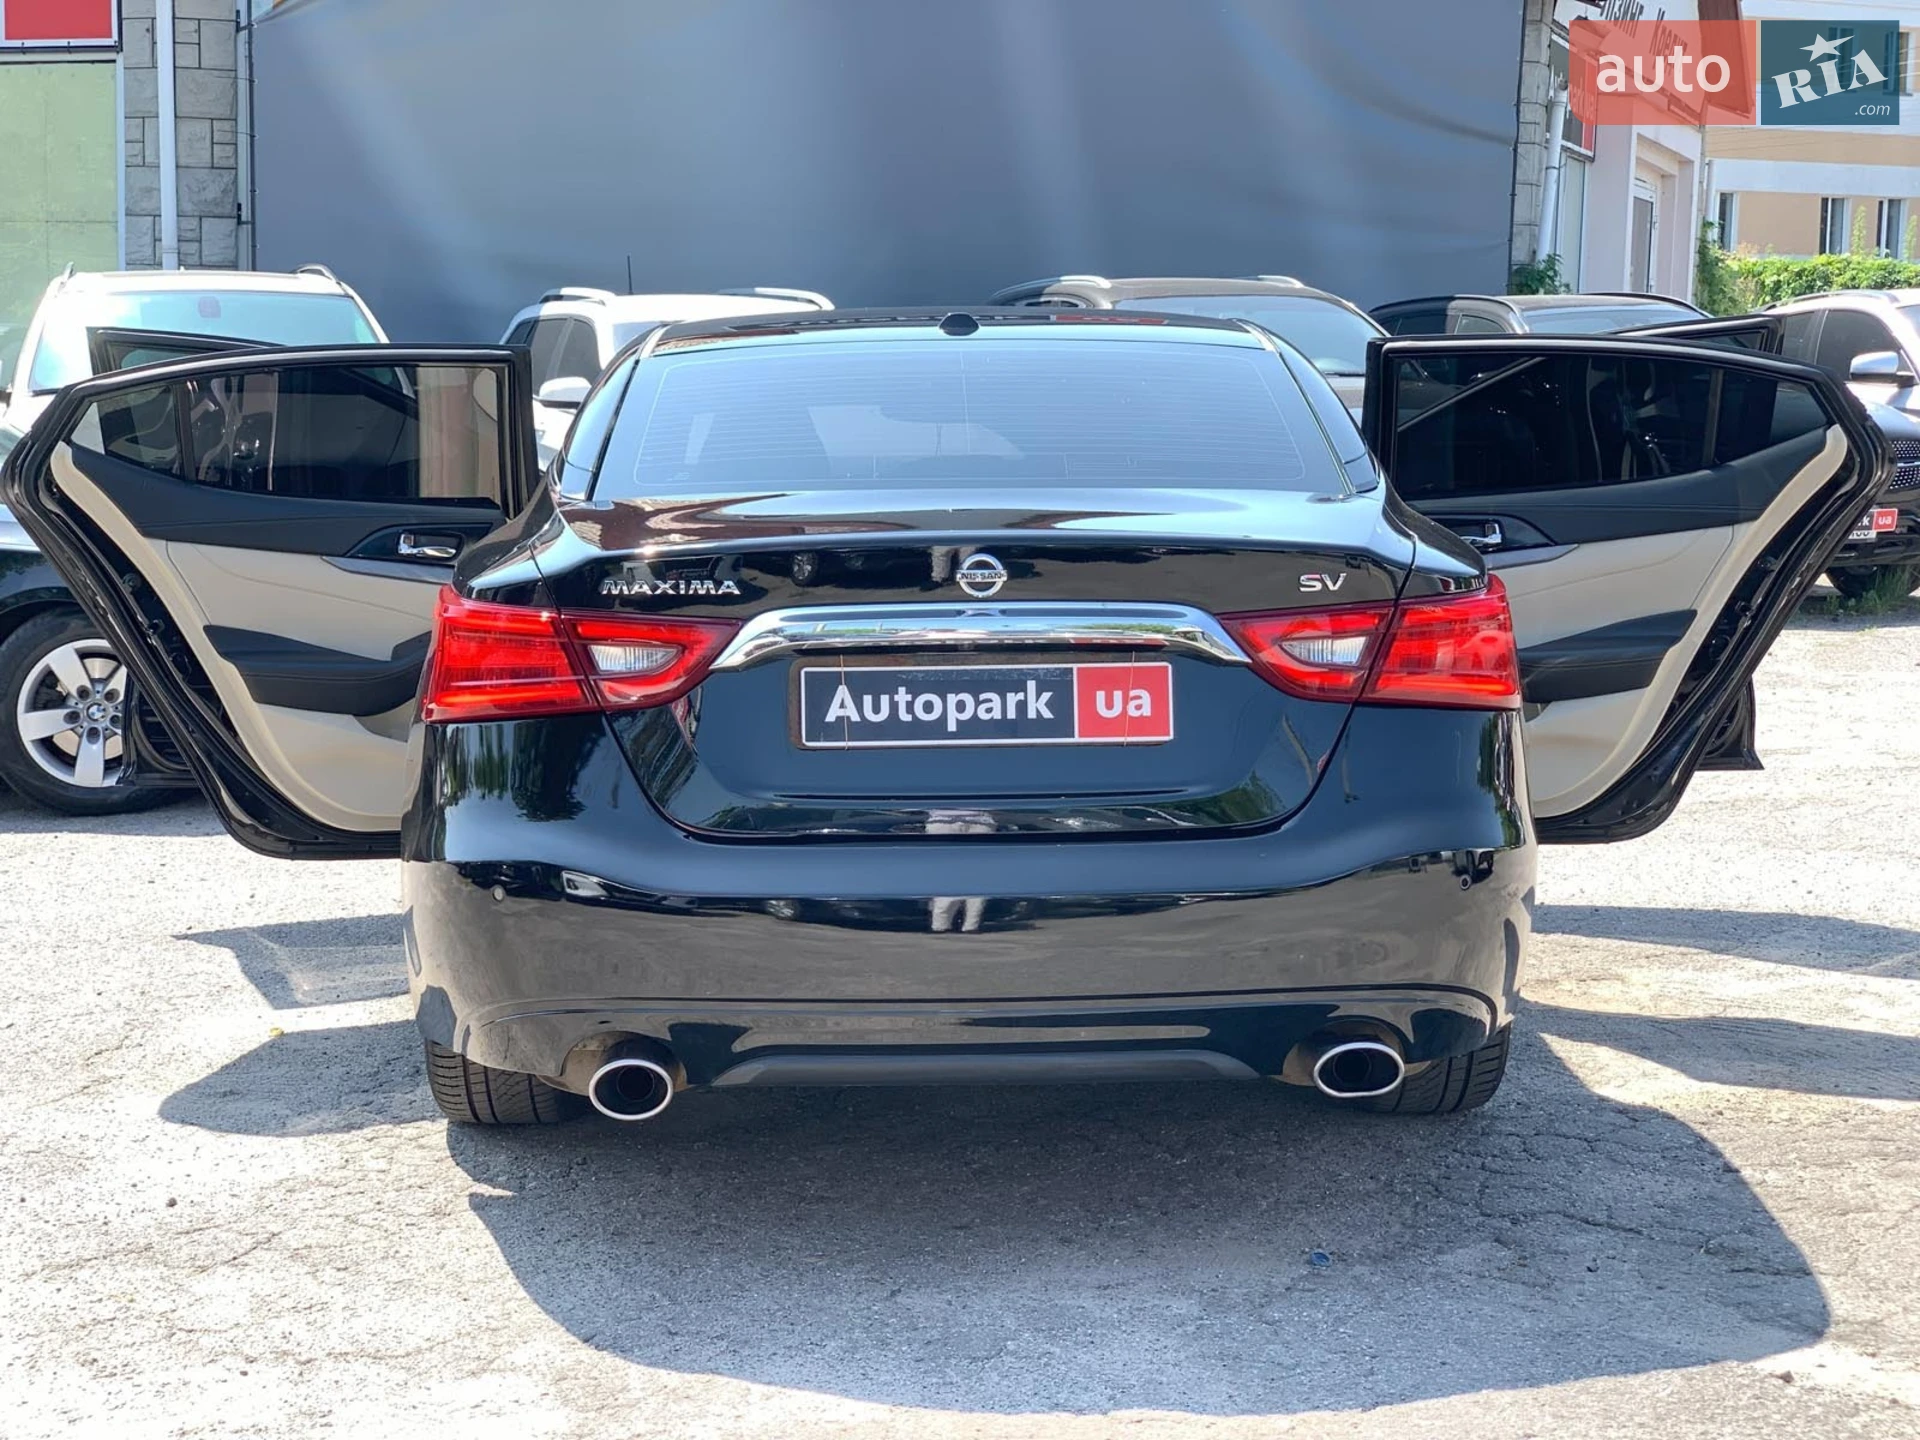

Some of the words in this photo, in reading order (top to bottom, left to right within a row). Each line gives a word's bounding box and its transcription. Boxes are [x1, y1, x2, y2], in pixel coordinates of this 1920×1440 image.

[1878, 516, 1893, 525] ua
[960, 572, 1003, 580] NISSAN
[1299, 572, 1347, 592] SV
[601, 579, 742, 595] MAXIMA
[824, 680, 1054, 732] Autopark
[1095, 688, 1152, 718] ua
